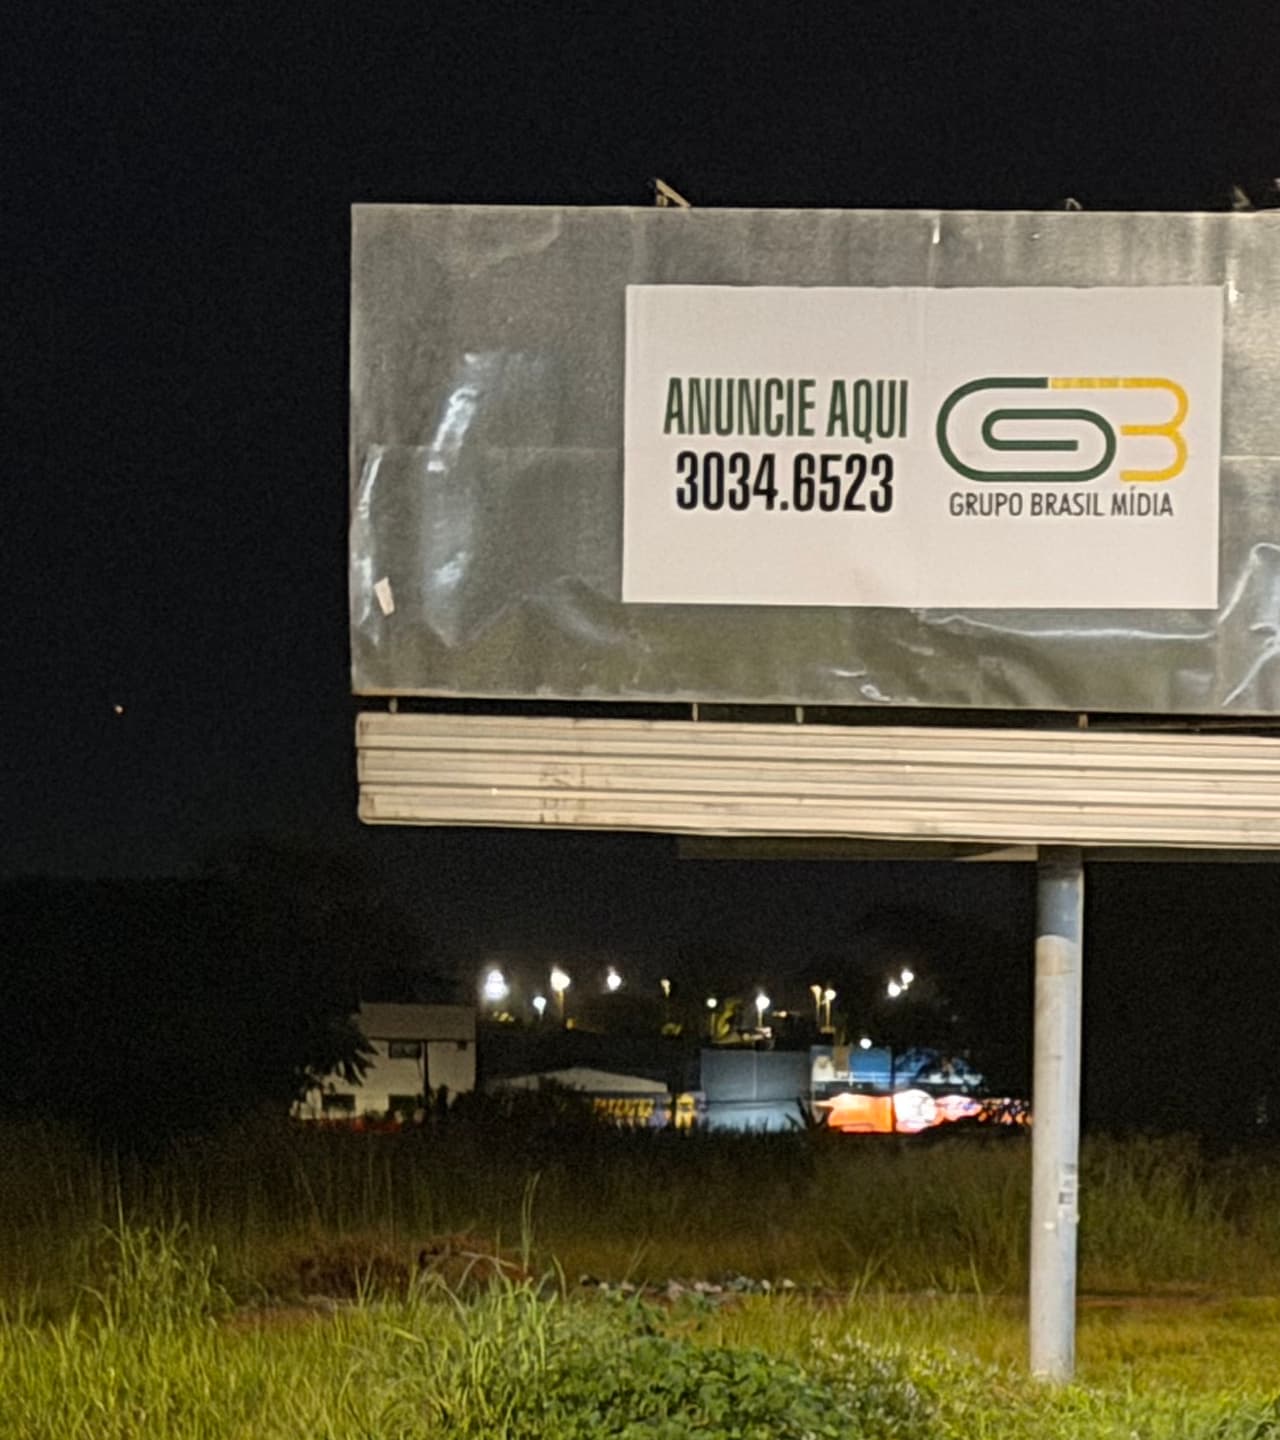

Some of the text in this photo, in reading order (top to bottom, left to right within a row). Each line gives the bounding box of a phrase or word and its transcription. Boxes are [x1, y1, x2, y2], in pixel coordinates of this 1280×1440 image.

[663, 376, 909, 445] ANUNCIE AQUI
[675, 450, 894, 513] 3034.6523
[949, 486, 1174, 518] GRUPO BRASIL MÍDIA
